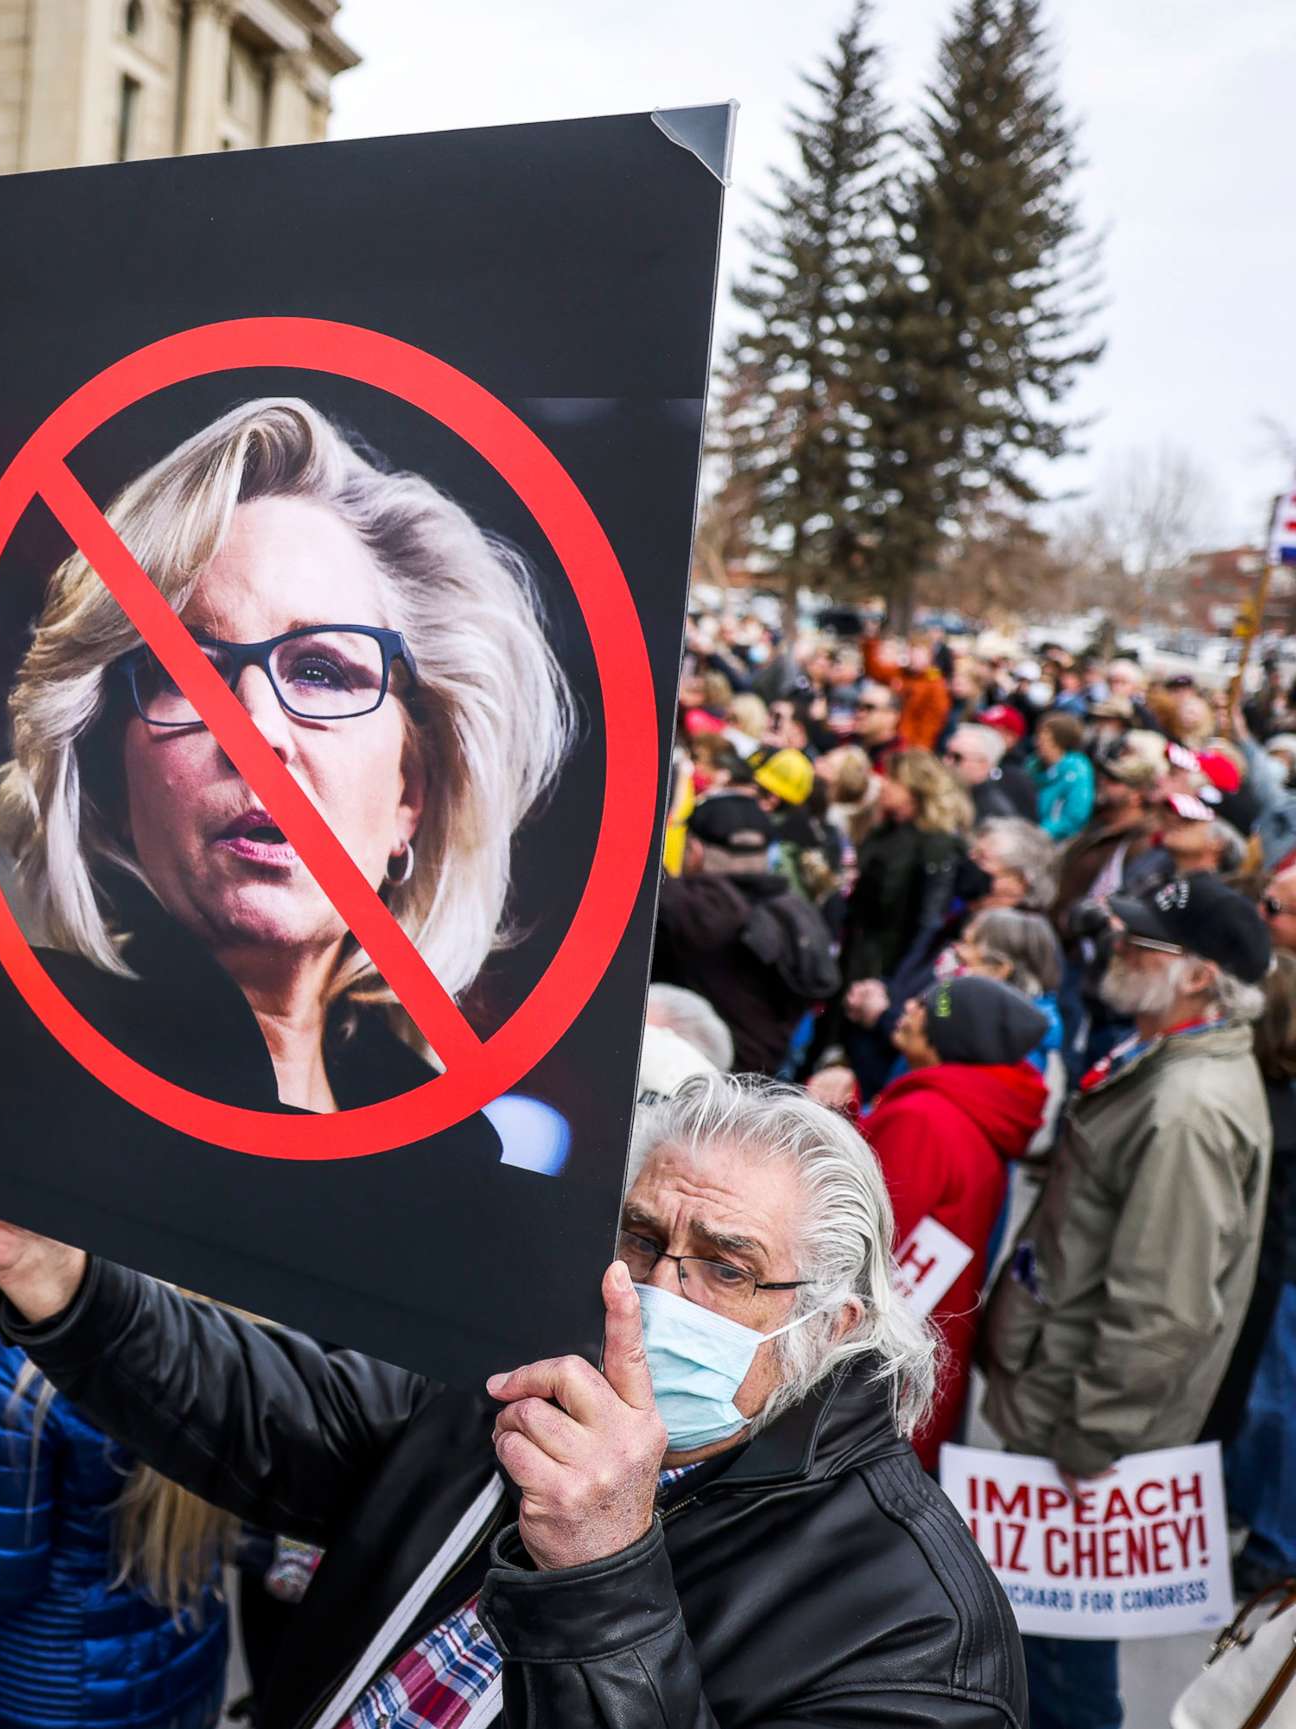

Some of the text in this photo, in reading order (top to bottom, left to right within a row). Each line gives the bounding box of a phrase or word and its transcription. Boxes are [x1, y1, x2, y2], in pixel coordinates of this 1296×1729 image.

[967, 1472, 1204, 1525] IMPEACH
[1044, 1514, 1209, 1578] CHENEY!
[1080, 1589, 1115, 1613] FOR
[1120, 1578, 1209, 1611] CONGRESS
